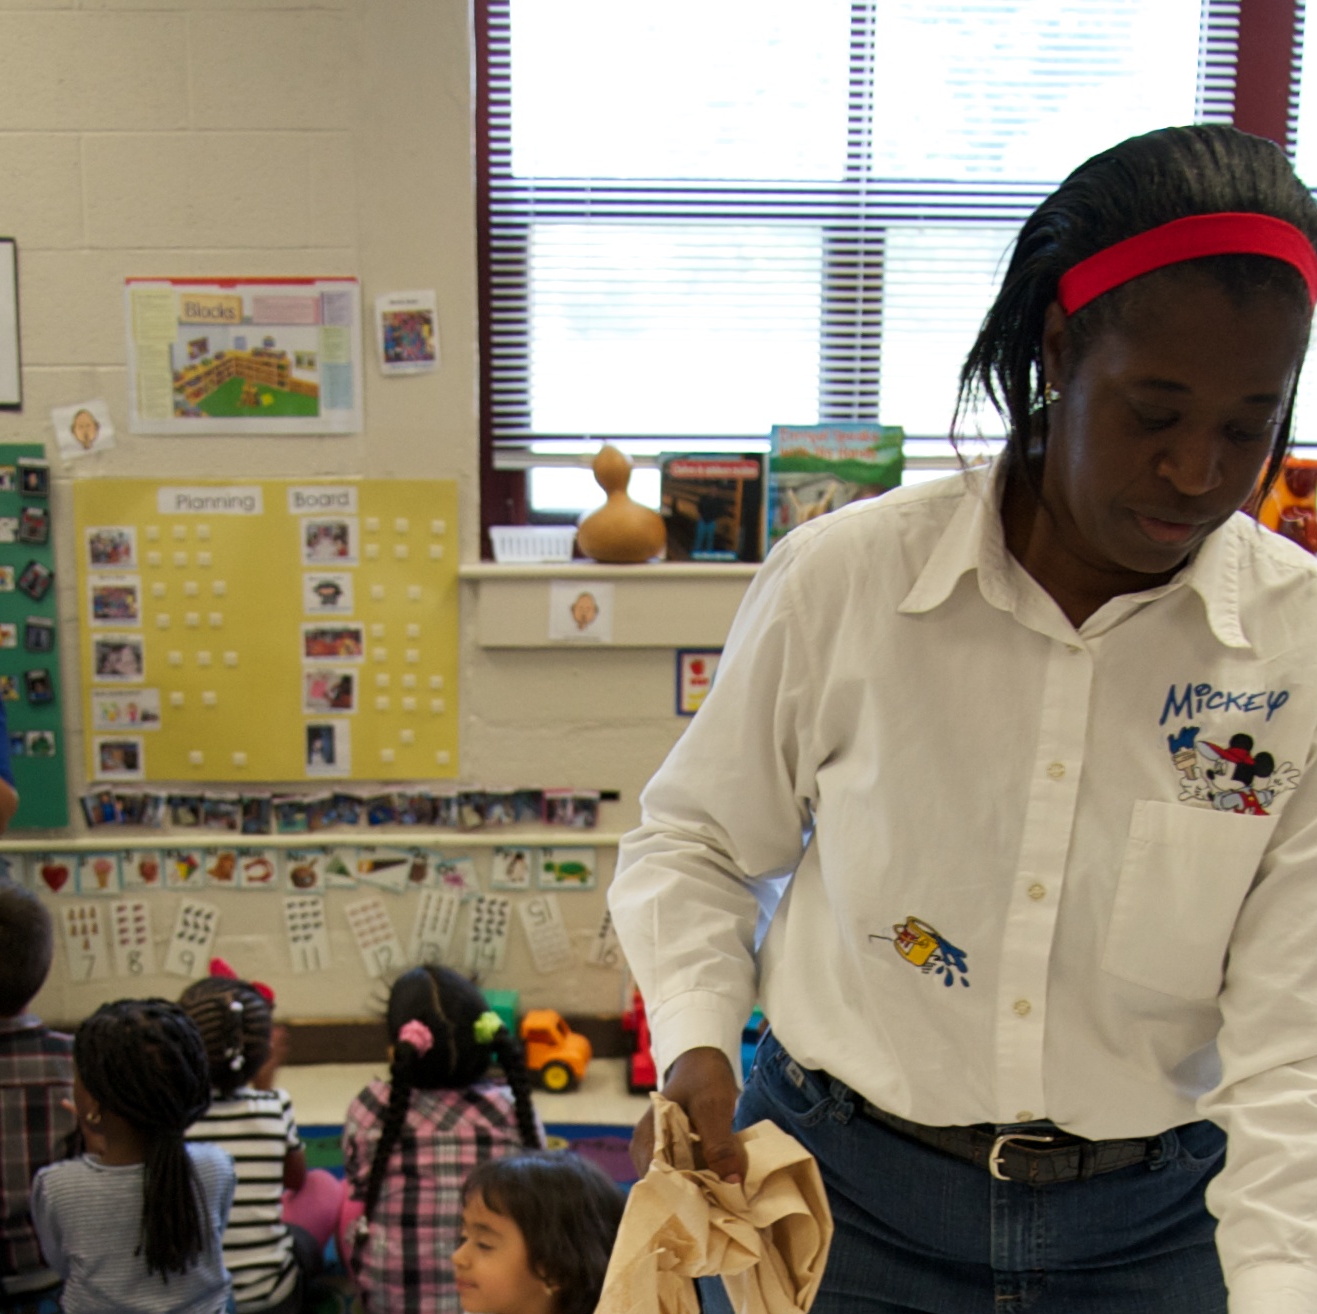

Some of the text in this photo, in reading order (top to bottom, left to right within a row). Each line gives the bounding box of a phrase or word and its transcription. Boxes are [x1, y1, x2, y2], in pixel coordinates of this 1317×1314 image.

[184, 302, 237, 320] Blocks
[175, 490, 350, 512] Planning Board
[82, 953, 97, 980] 7
[127, 950, 144, 977] 8
[179, 950, 195, 976] 9
[303, 948, 321, 972] 11
